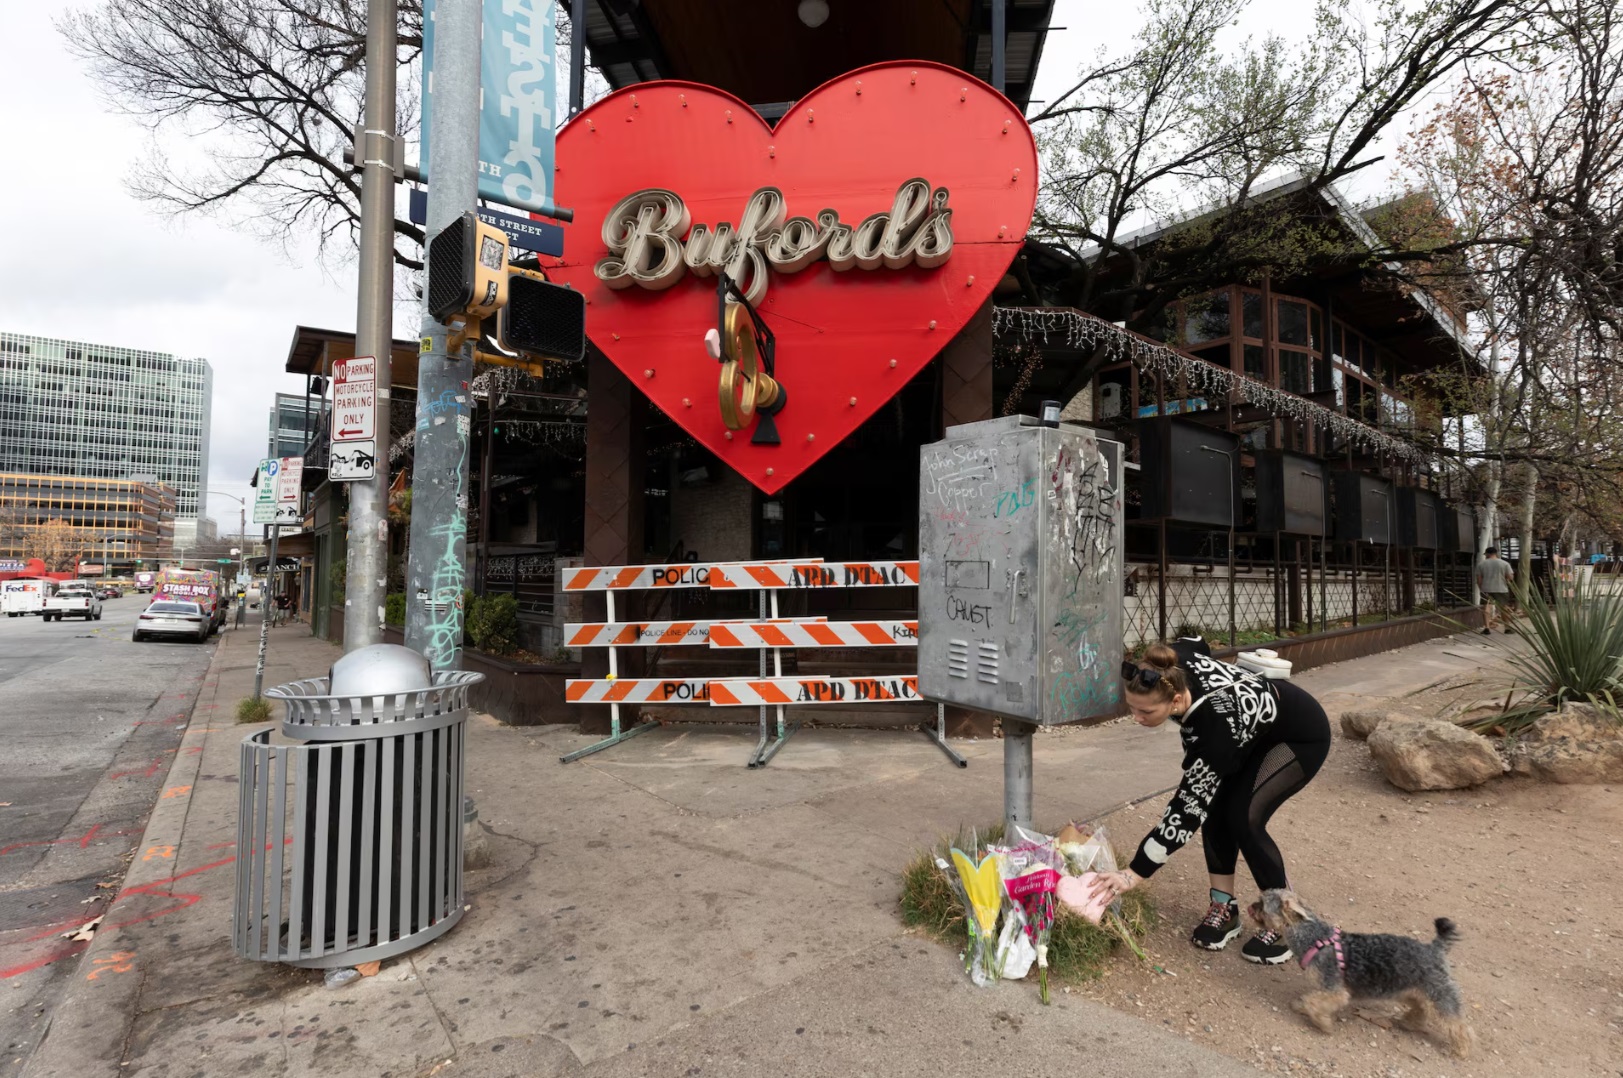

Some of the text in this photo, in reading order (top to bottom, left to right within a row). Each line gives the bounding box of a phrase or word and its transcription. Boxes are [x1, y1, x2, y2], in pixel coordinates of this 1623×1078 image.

[478, 160, 501, 177] TH
[500, 219, 542, 236] STREET
[594, 177, 954, 308] Buford's
[334, 363, 374, 380] NO PARKING
[335, 382, 373, 395] MOTORCYCLE
[337, 397, 372, 409] PARKING
[343, 413, 364, 425] ONLY
[652, 567, 709, 585] POLIC
[787, 566, 906, 586] APD DTAC
[6, 584, 37, 592] FedEx
[163, 583, 210, 596] STASH BOX
[640, 629, 664, 637] POLICE
[666, 629, 682, 637] LINE
[664, 683, 710, 699] POLI
[796, 679, 917, 701] APD DTAC
[1014, 882, 1041, 895] Garden
